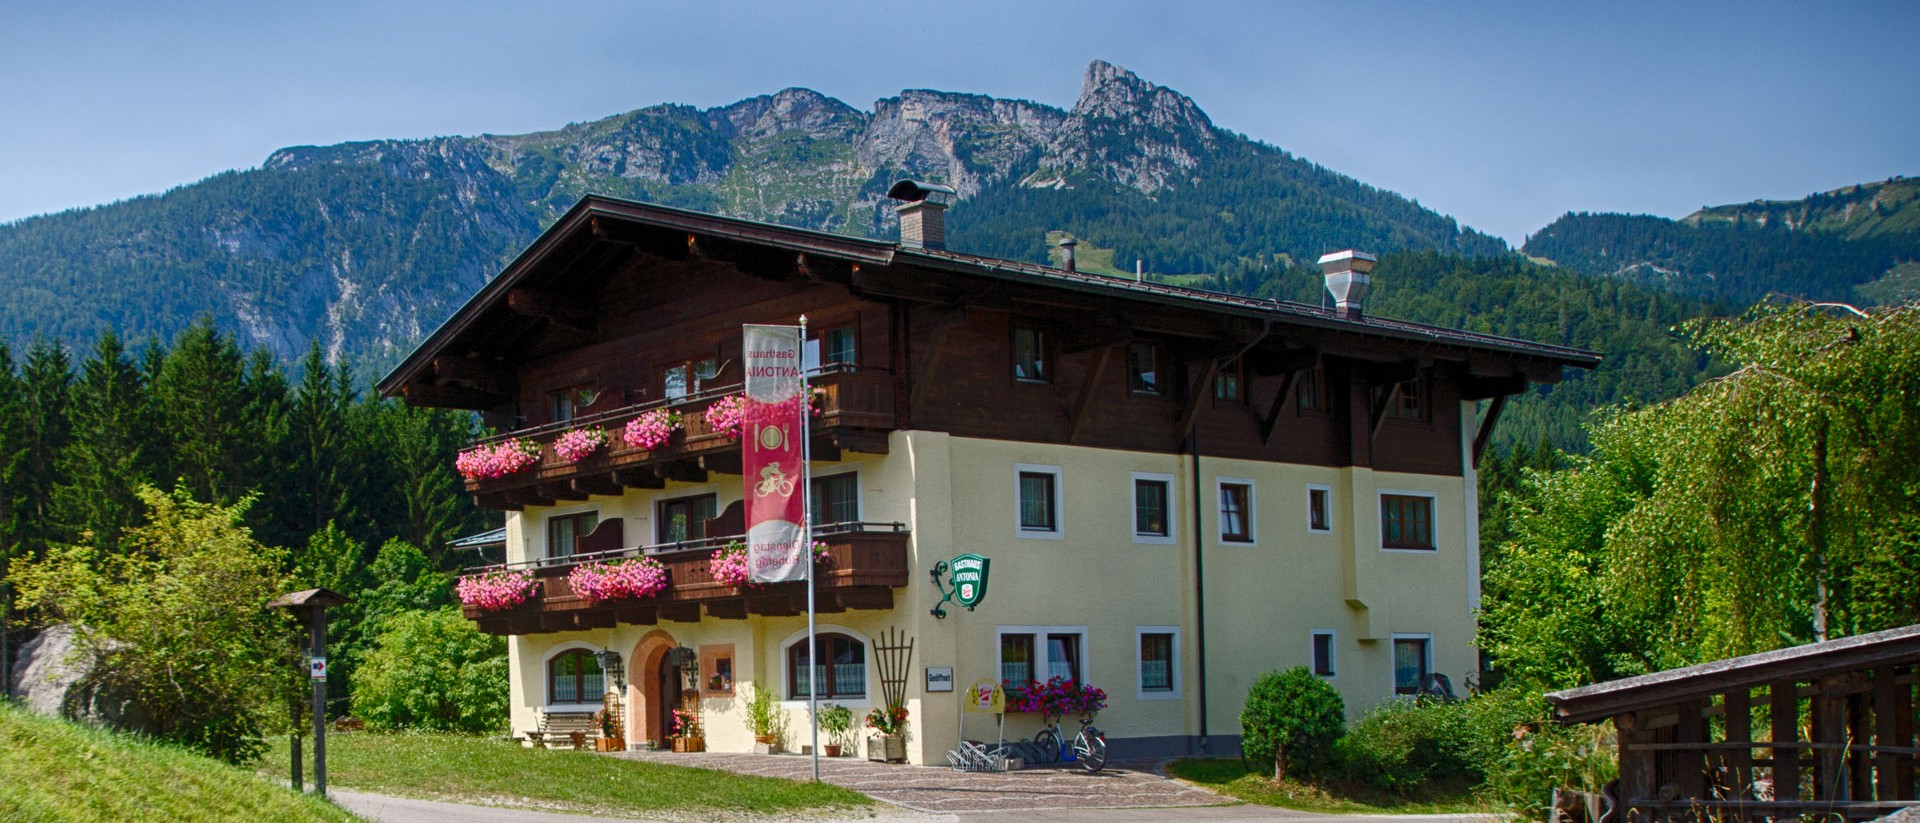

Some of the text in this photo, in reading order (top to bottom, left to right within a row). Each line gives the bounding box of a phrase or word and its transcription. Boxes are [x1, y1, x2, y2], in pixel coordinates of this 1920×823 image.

[954, 559, 981, 571] GASTHAUS
[956, 572, 979, 582] ANTONIA
[929, 673, 951, 682] Geöffnet
